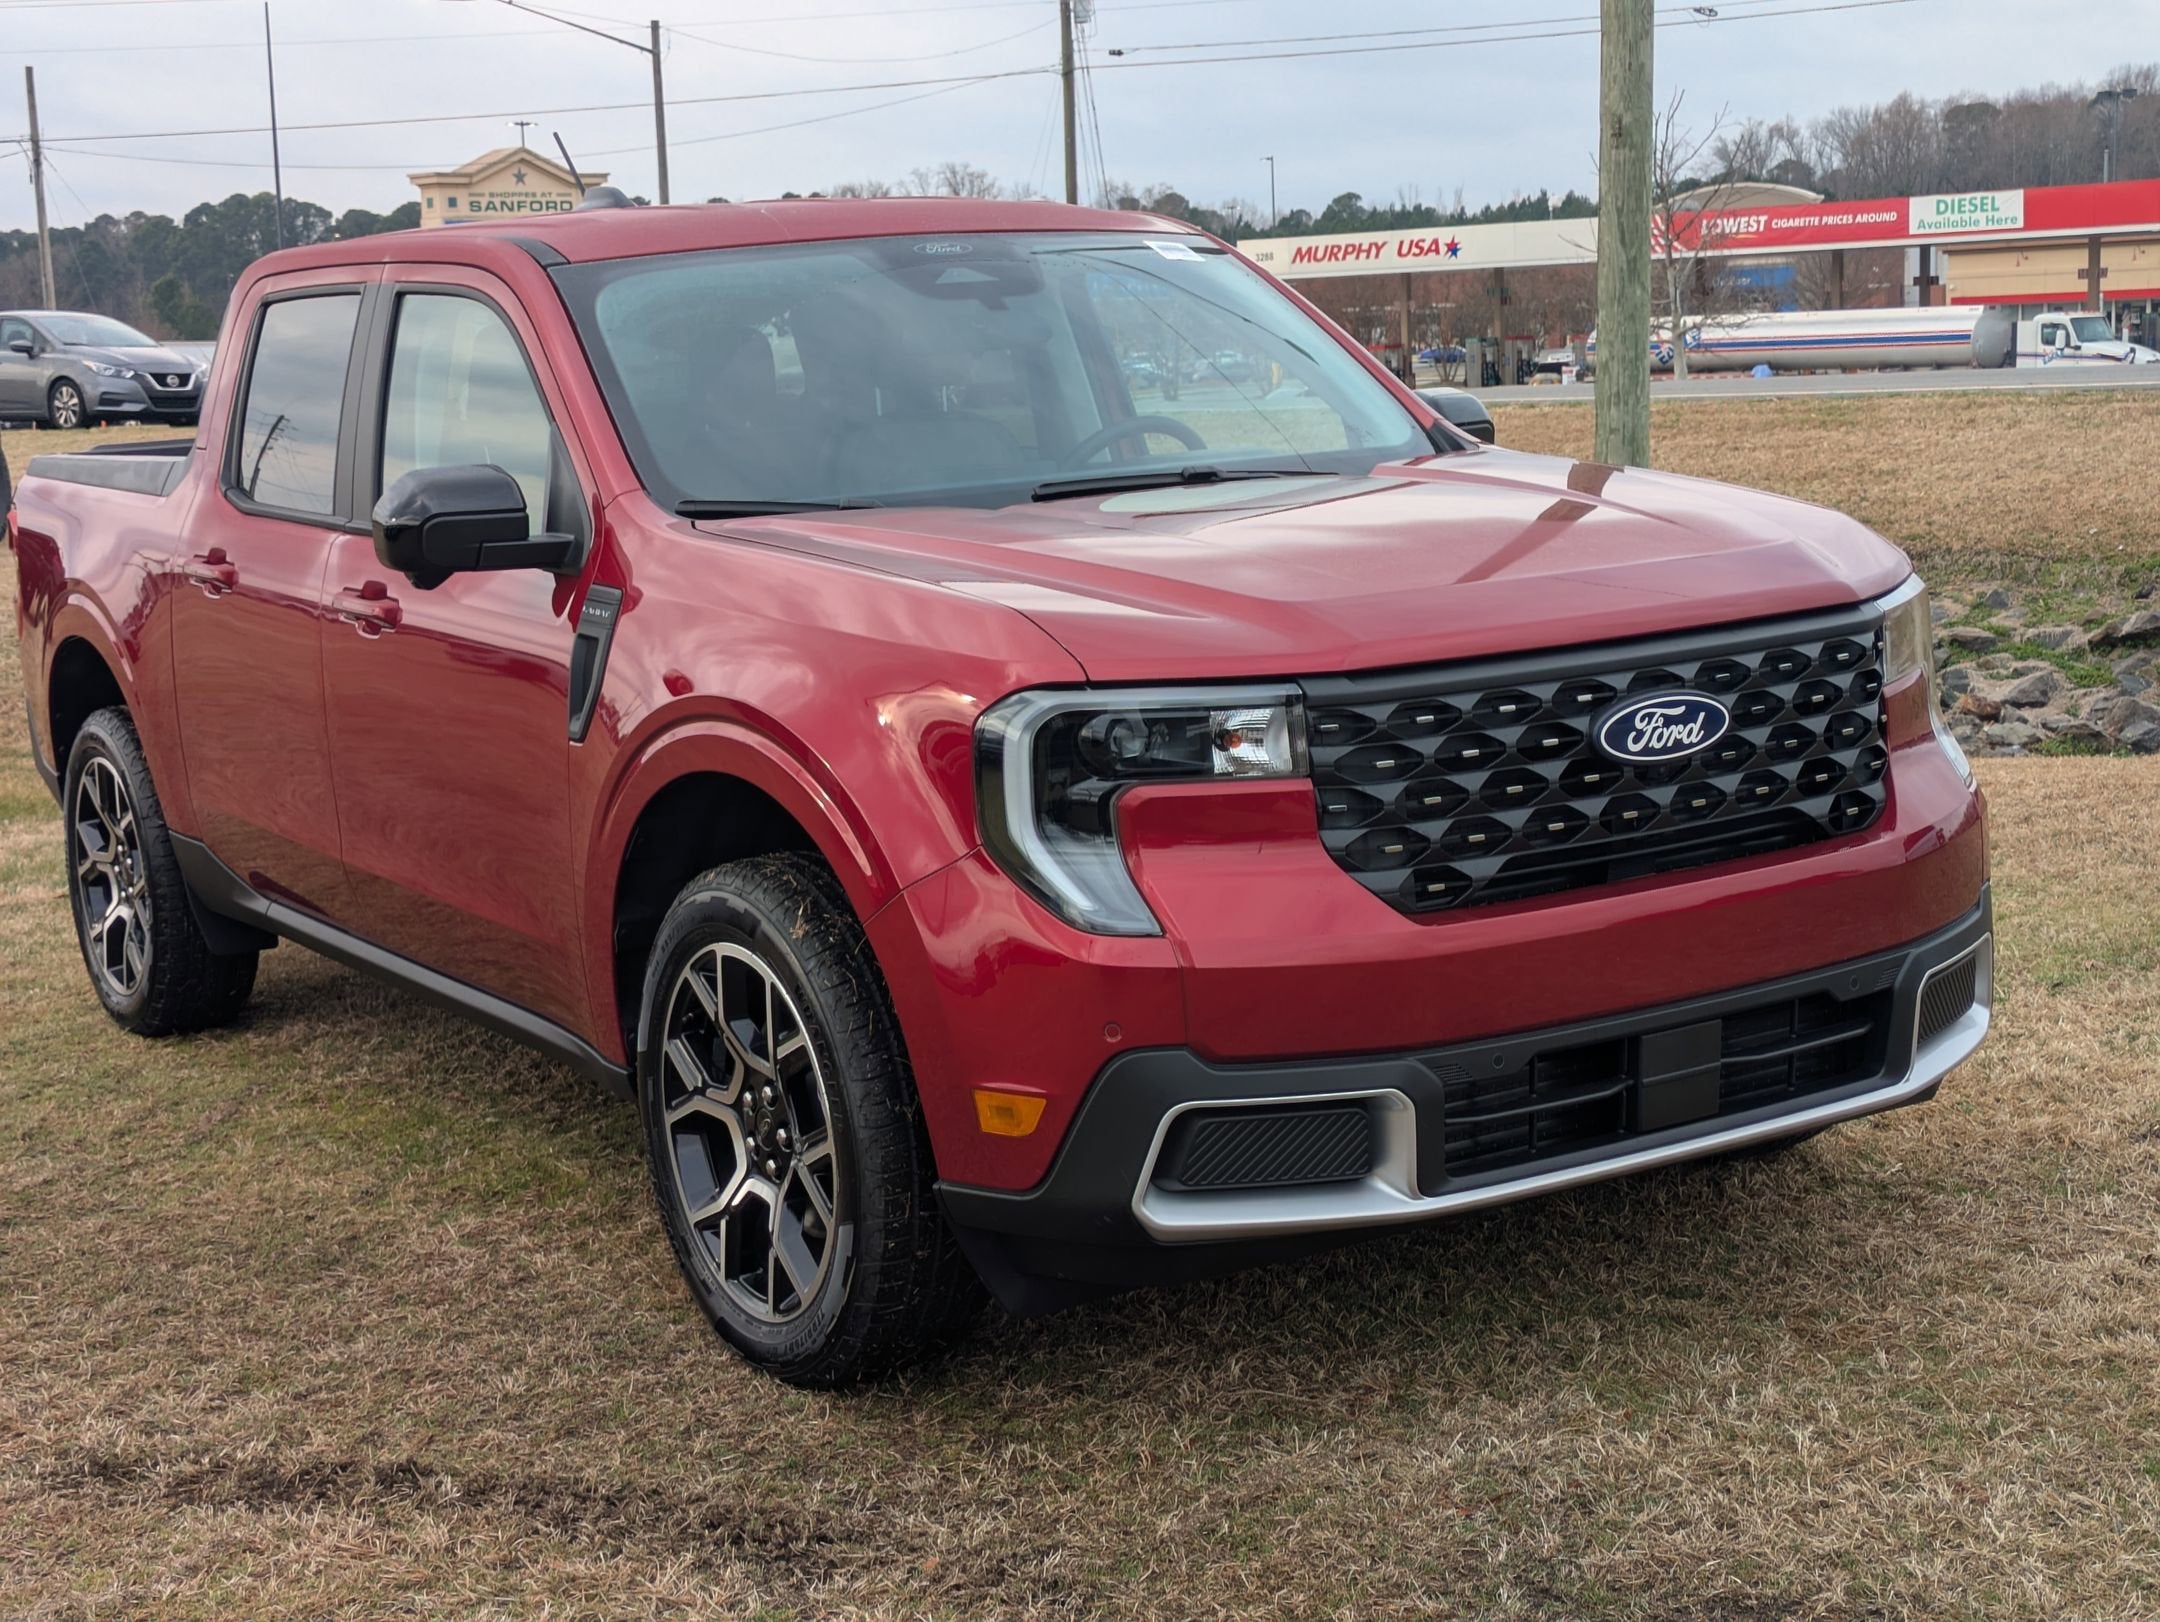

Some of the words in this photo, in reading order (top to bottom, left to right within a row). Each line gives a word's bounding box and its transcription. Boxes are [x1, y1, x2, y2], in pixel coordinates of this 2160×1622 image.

[469, 200, 573, 212] SANFORD
[1935, 195, 2000, 215] DIESEL
[1701, 215, 1768, 235] LOWEST
[1771, 217, 1819, 229] CIGARETTE
[1821, 214, 1853, 226] PRICES
[1855, 211, 1898, 224] AROUND
[1917, 216, 1980, 230] Available
[1985, 214, 2018, 227] Here
[1291, 241, 1388, 264] MURPHY
[1397, 238, 1441, 258] USA
[1627, 705, 1706, 752] Ford
